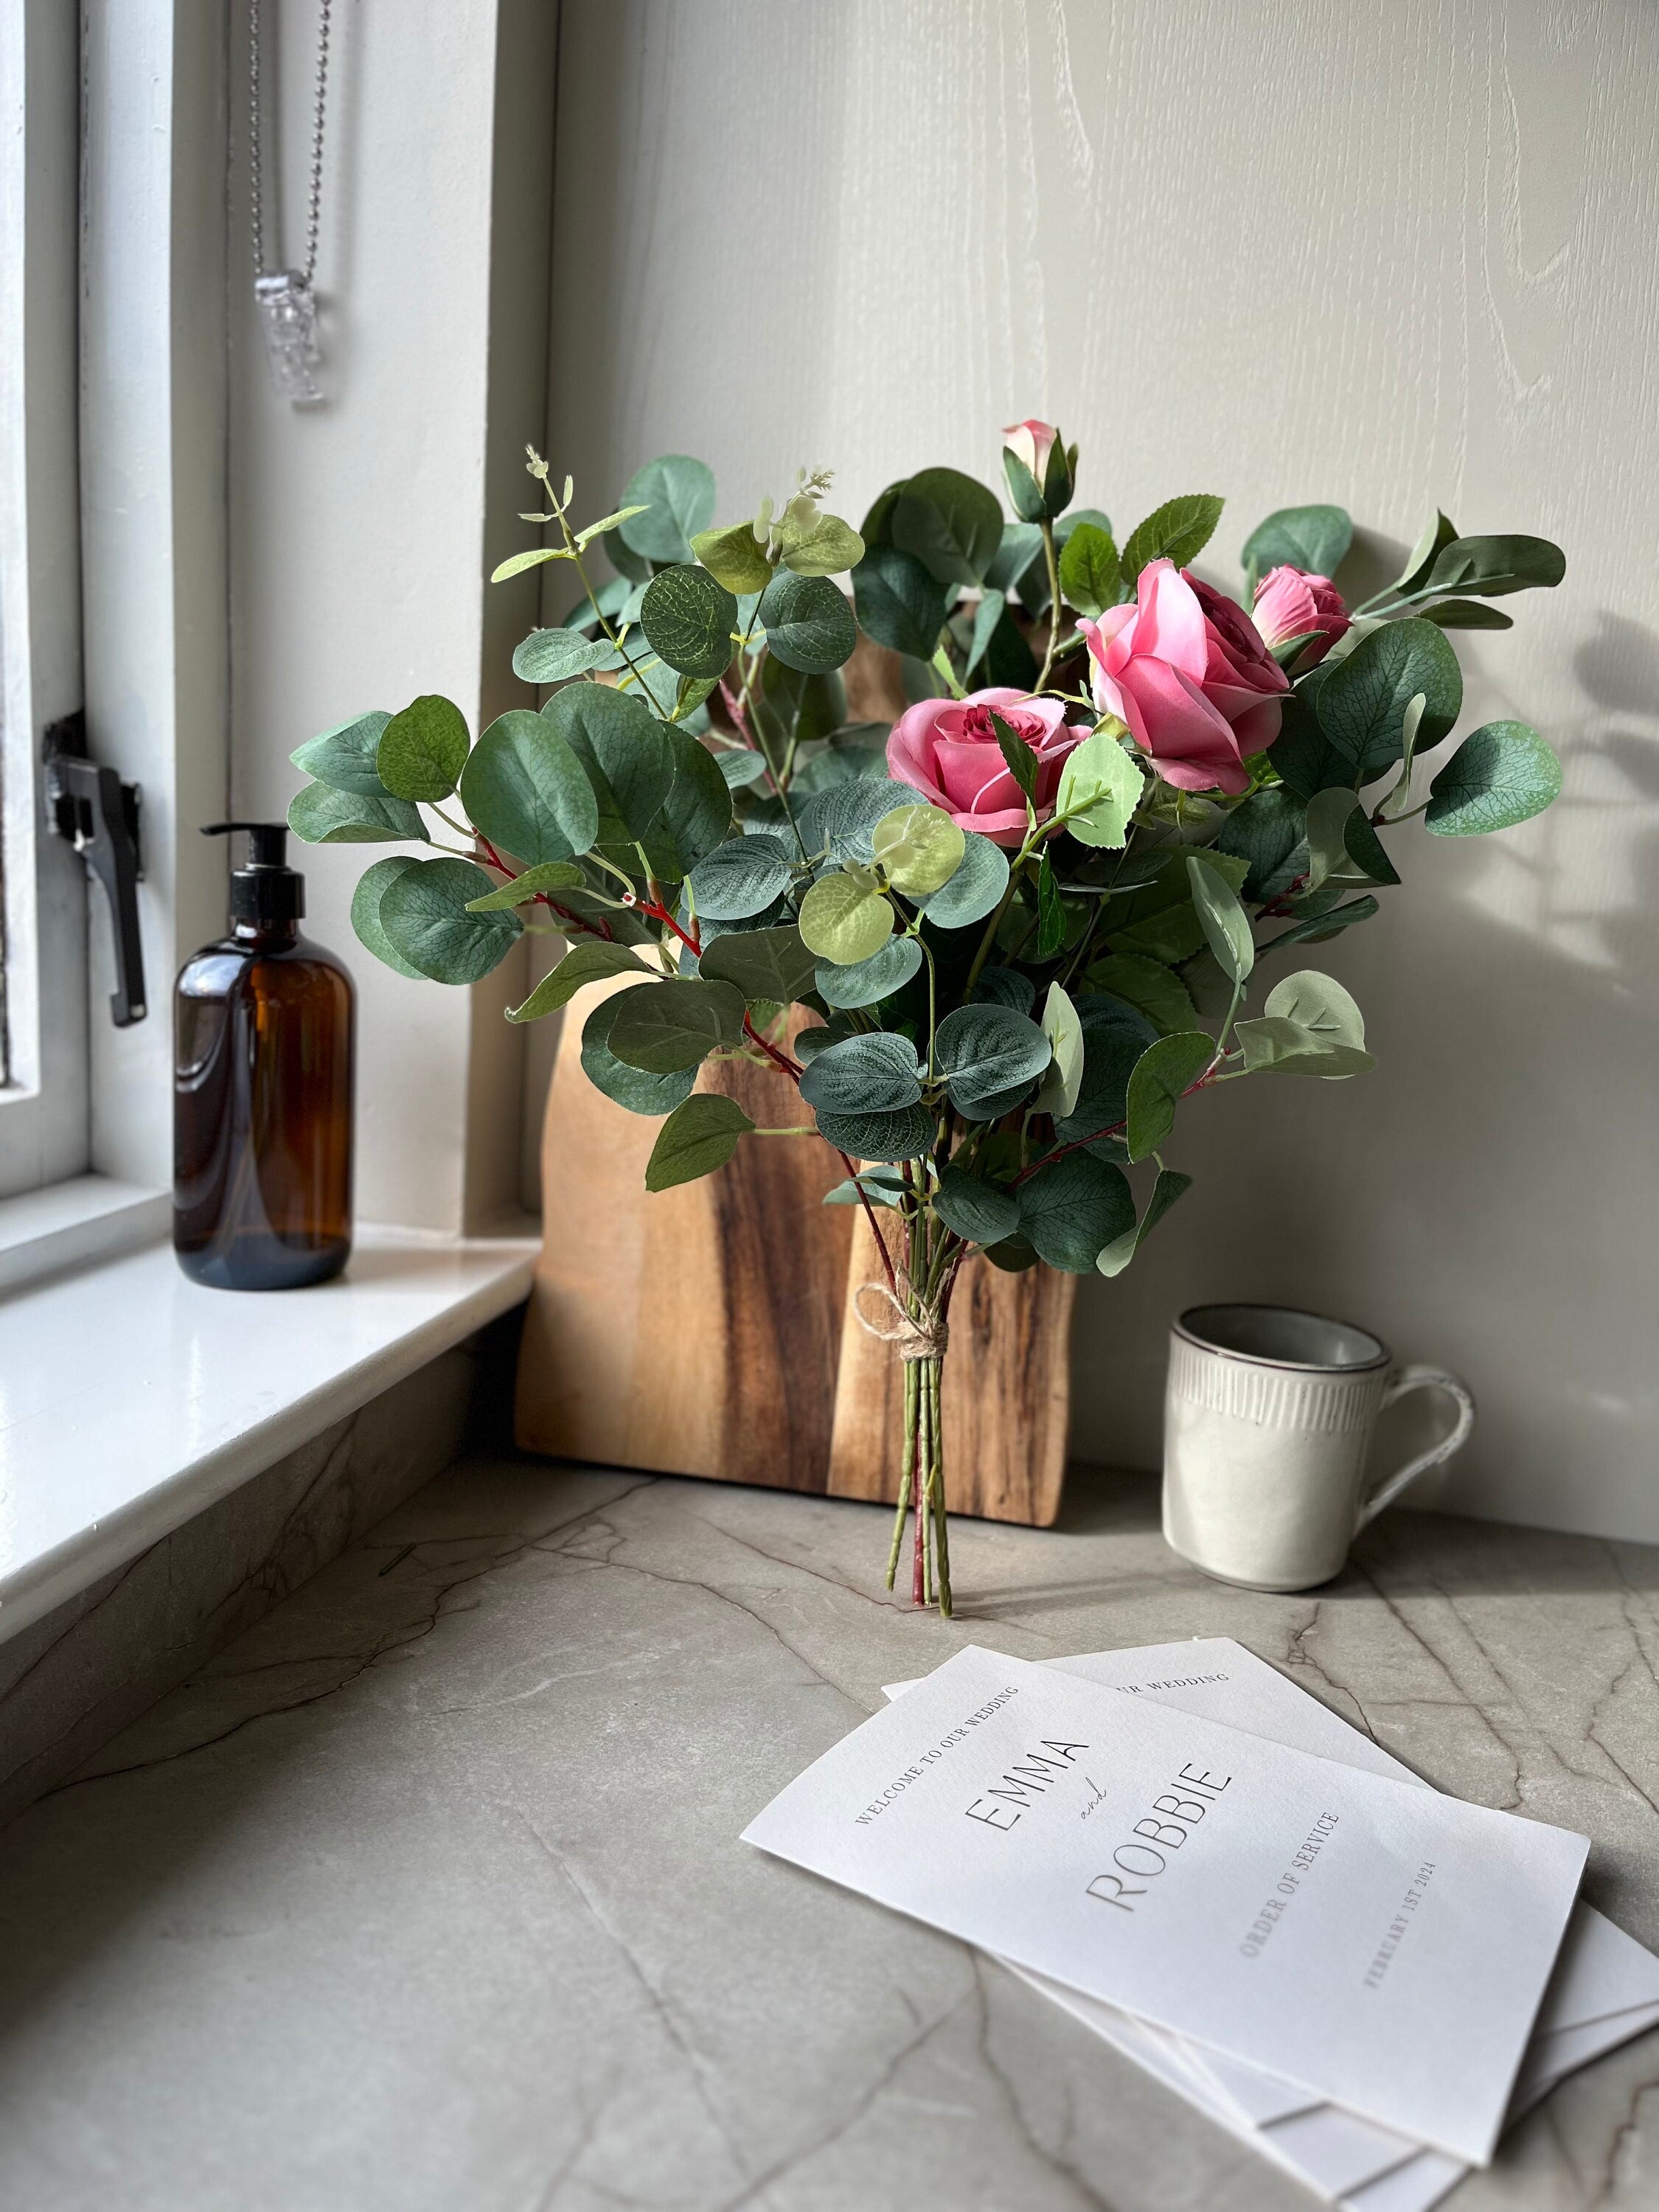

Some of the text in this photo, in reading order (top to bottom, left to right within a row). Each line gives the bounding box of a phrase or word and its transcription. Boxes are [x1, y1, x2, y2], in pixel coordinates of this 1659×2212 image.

[1116, 1674, 1230, 1694] UR WEDDING
[854, 1686, 1019, 1826] WELCOME TO OUR WEDDING
[964, 1740, 1090, 1832] EMMA
[1080, 1776, 1107, 1820] and
[1085, 1762, 1232, 1913] ROBBIE
[1239, 1812, 1339, 1958] ORDER OF SERVICE
[1402, 1889, 1422, 1911] 1ST
[1414, 1861, 1436, 1887] 2024
